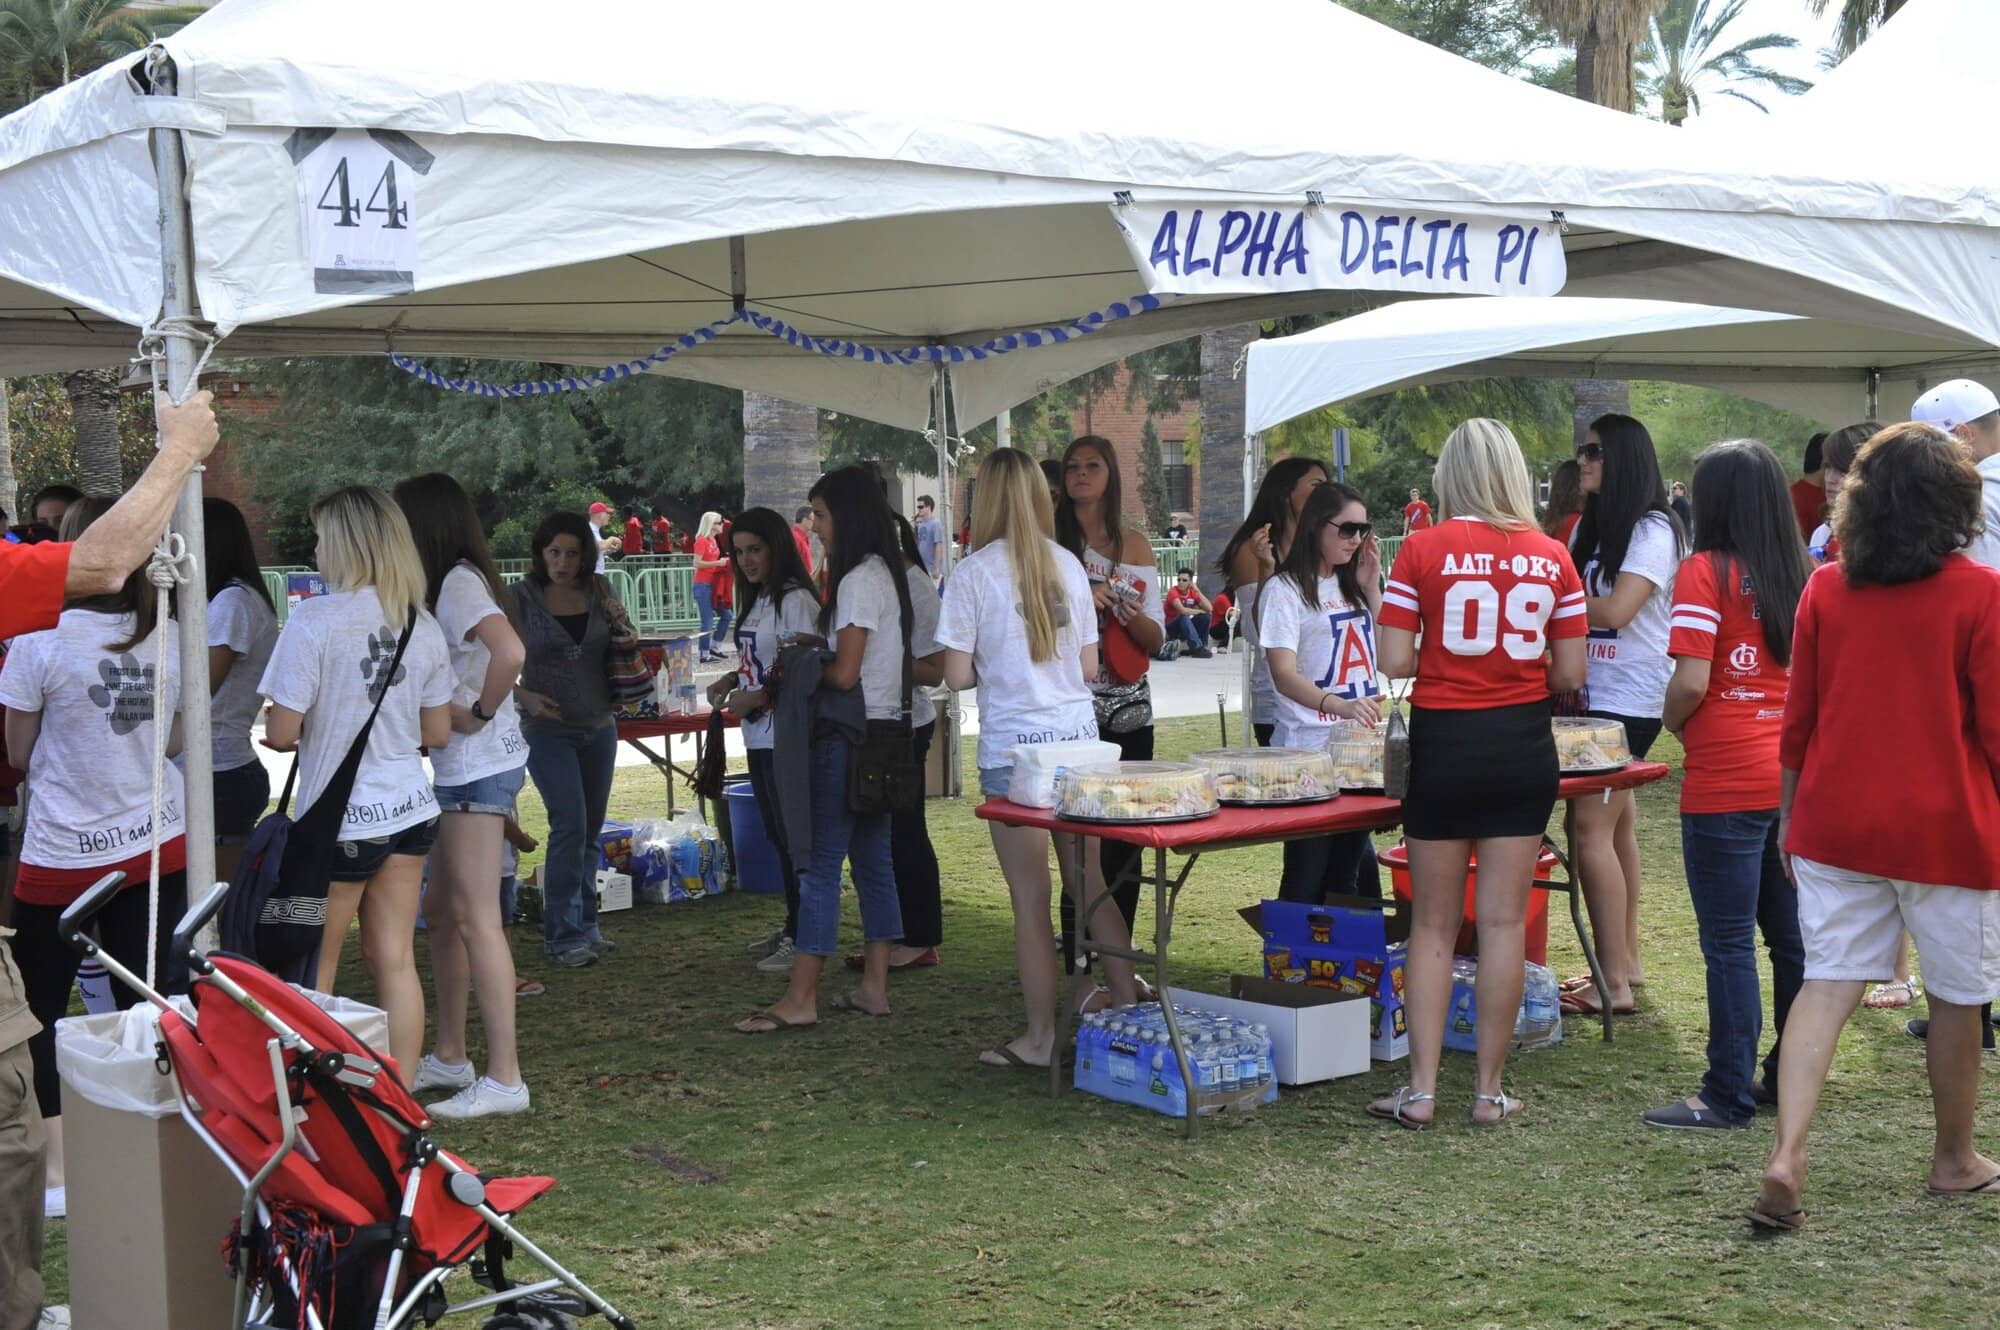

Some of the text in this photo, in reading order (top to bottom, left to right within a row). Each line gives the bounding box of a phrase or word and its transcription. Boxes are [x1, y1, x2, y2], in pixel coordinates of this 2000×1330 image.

[317, 156, 408, 230] 44
[1150, 209, 1540, 286] ALPHA DELTA PI
[1442, 580, 1556, 661] 09
[128, 813, 153, 841] and
[392, 795, 414, 818] and
[1310, 960, 1336, 978] 50
